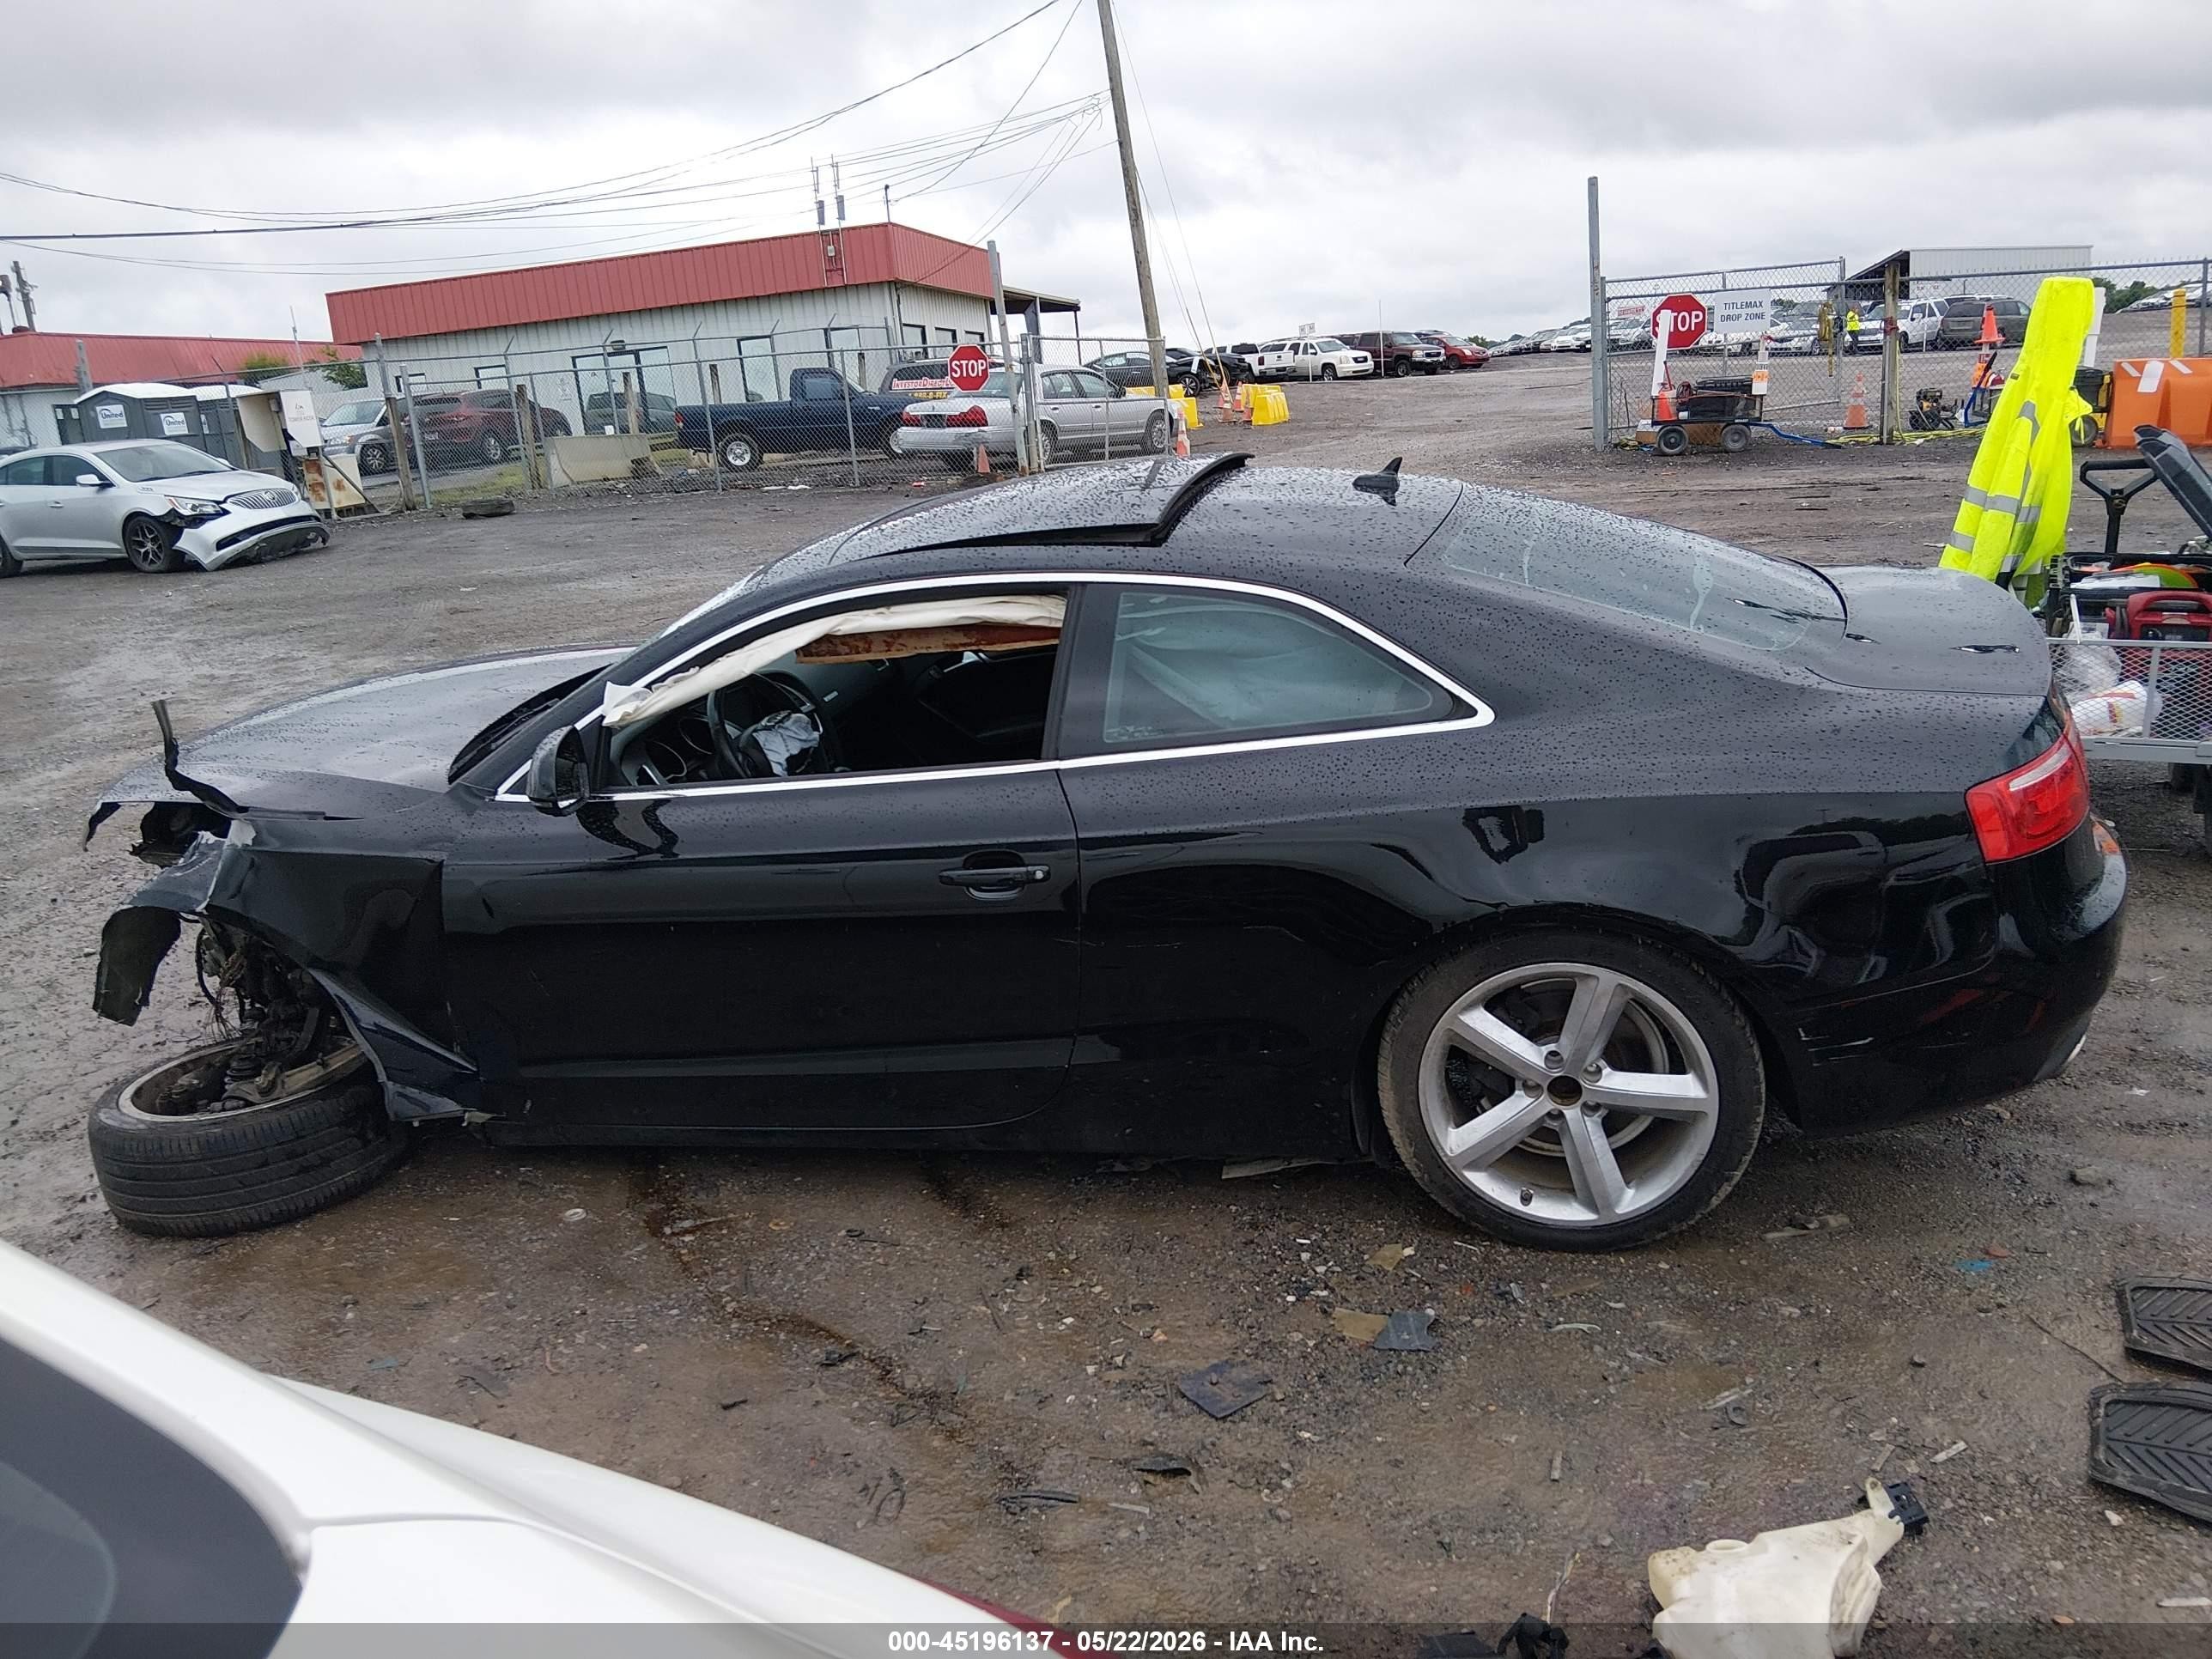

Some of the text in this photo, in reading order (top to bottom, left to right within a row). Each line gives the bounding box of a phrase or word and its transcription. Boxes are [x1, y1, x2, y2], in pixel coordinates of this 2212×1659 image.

[1723, 301, 1764, 310] TITLEMAX
[1720, 312, 1766, 323] DROP ZONE
[951, 360, 987, 378] STOP
[101, 411, 124, 420] United
